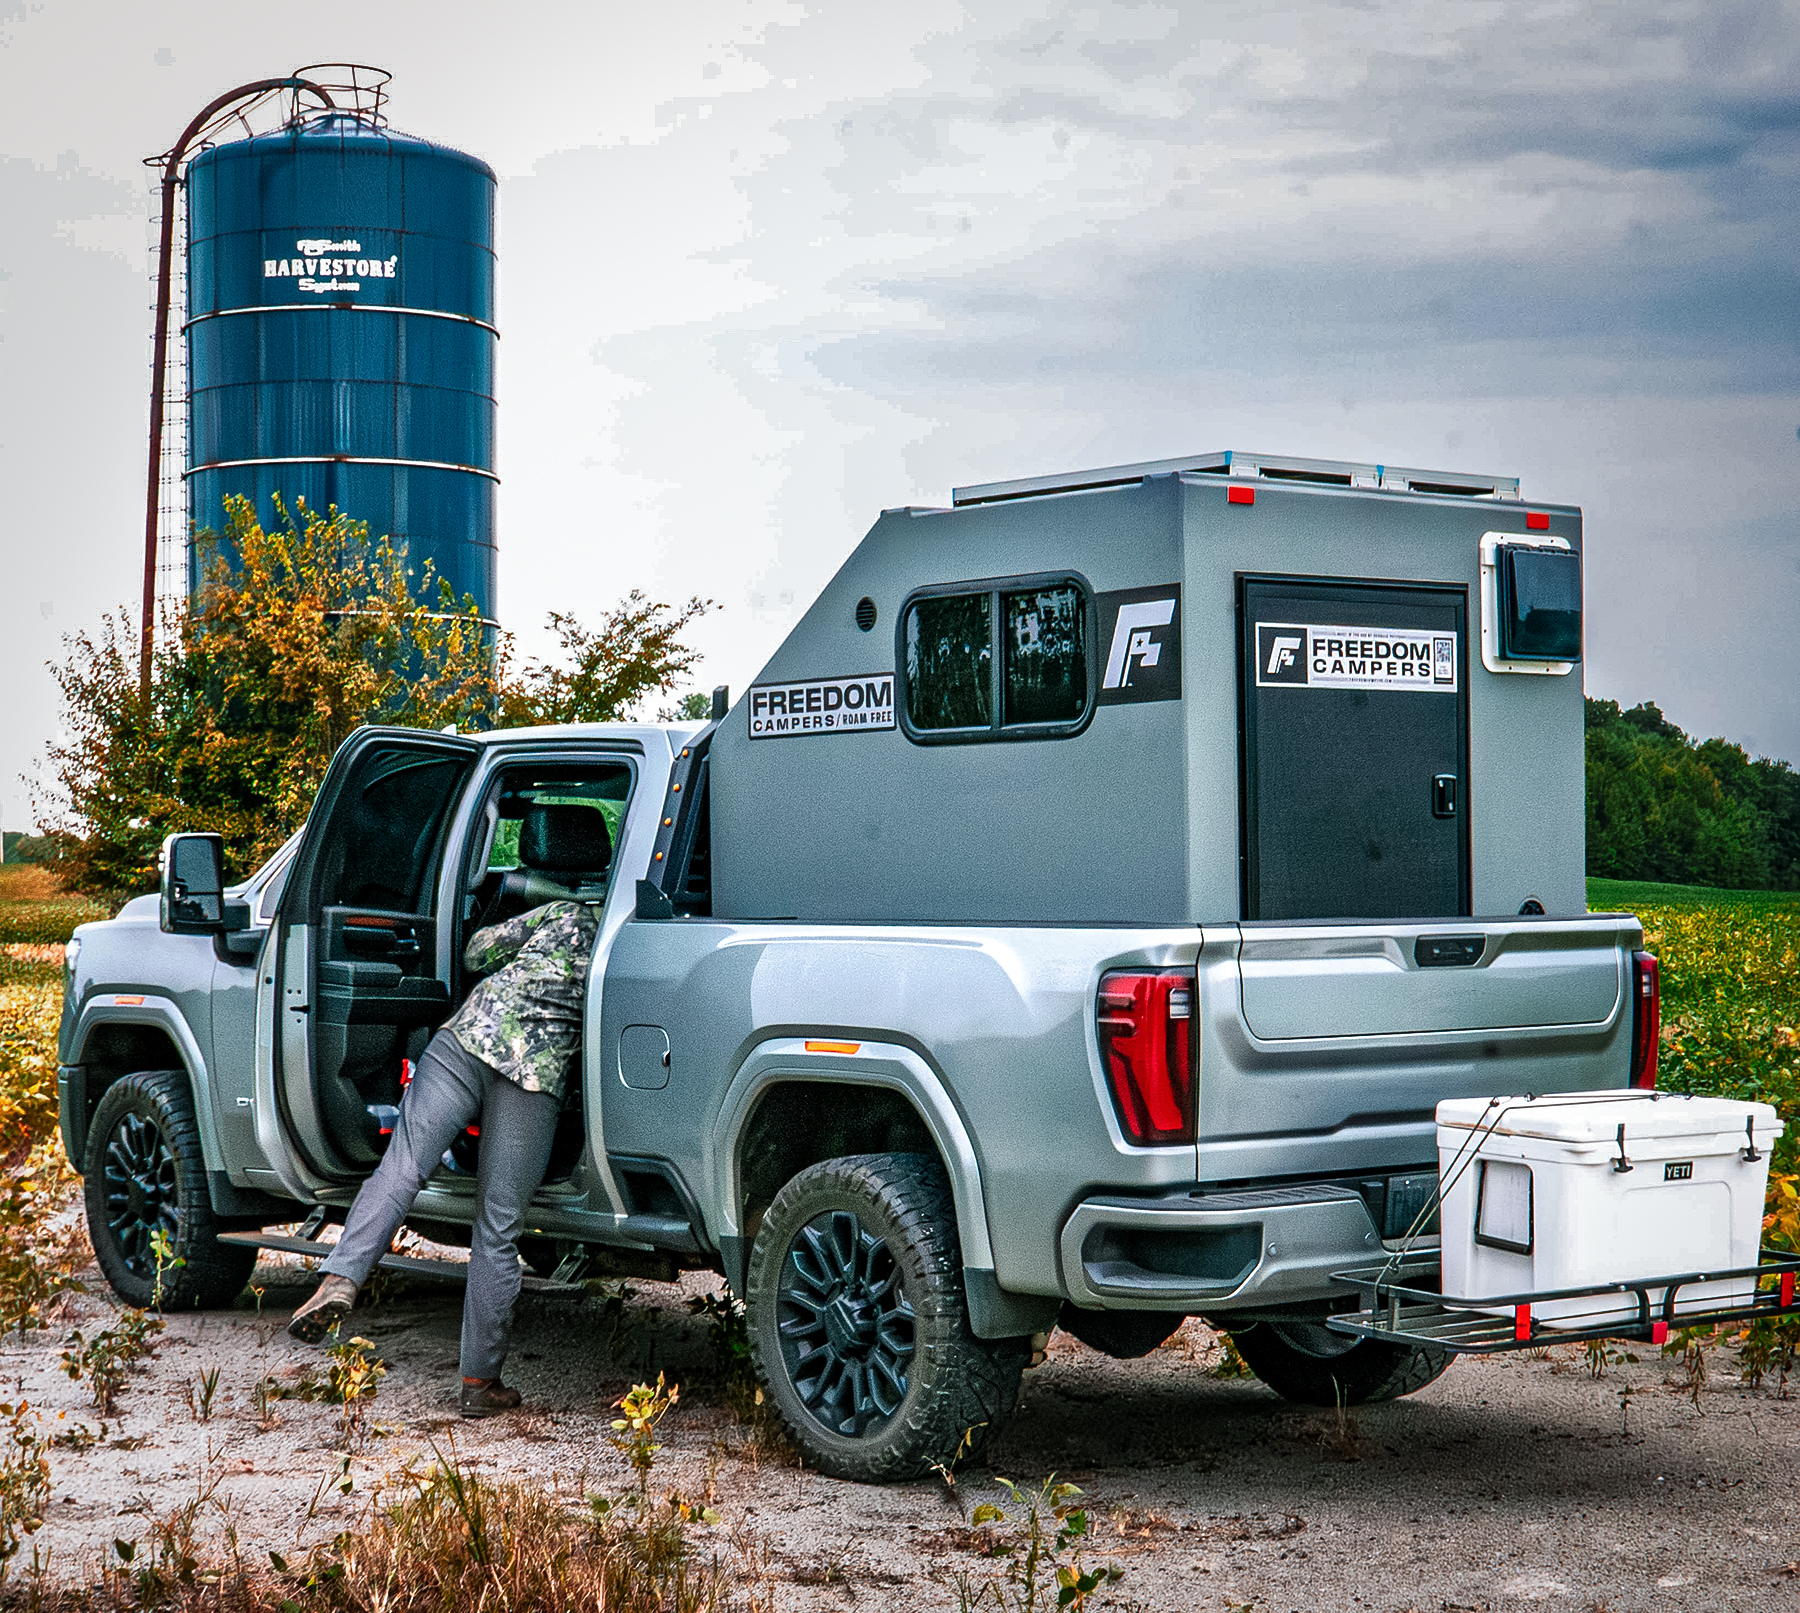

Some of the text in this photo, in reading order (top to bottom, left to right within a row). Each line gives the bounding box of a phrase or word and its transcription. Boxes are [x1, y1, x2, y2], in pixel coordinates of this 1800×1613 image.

[264, 258, 396, 277] HARVESTORE
[1312, 638, 1431, 661] FREEDOM
[1313, 658, 1431, 677] CAMPERS
[752, 682, 892, 717] FREEDOM
[870, 711, 893, 723] FREE
[1666, 1165, 1691, 1178] YETI
